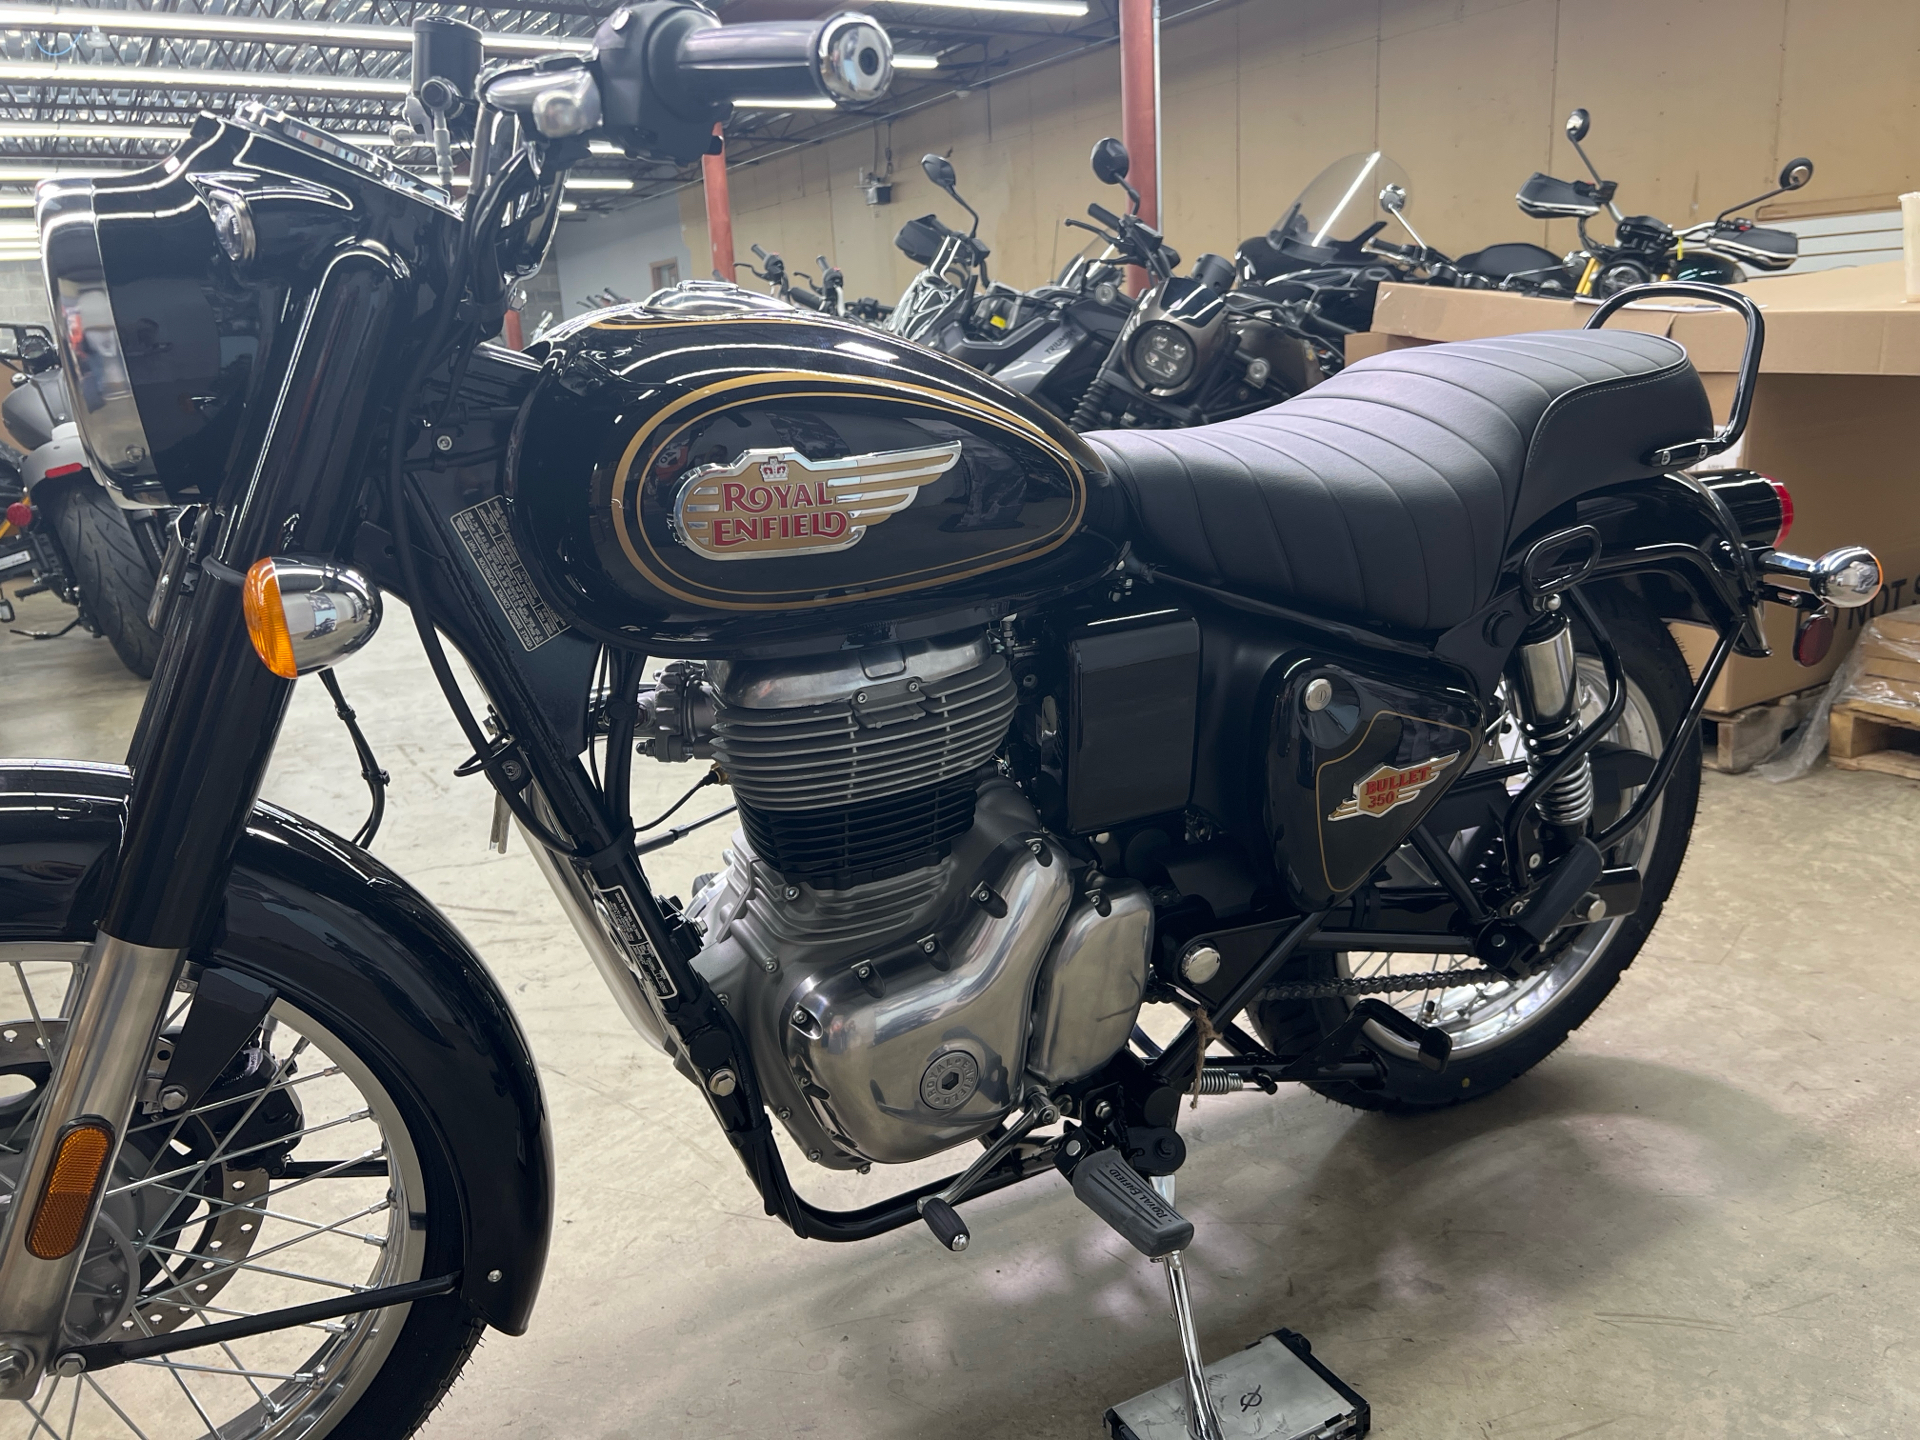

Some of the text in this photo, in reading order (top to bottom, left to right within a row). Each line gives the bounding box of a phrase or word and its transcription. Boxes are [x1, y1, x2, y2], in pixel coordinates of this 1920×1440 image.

[1044, 327, 1078, 354] TRIUMPH
[721, 481, 833, 513] ROYAL
[713, 510, 848, 547] ENFIELD
[466, 538, 478, 552] PART
[495, 587, 510, 609] CONTROL
[519, 629, 534, 648] VEHICLE
[1365, 767, 1432, 795] BULLET
[1367, 791, 1396, 809] 350
[926, 1058, 975, 1107] ROYAL ENFIELD
[1109, 1168, 1169, 1219] ROYAL ENFIELD
